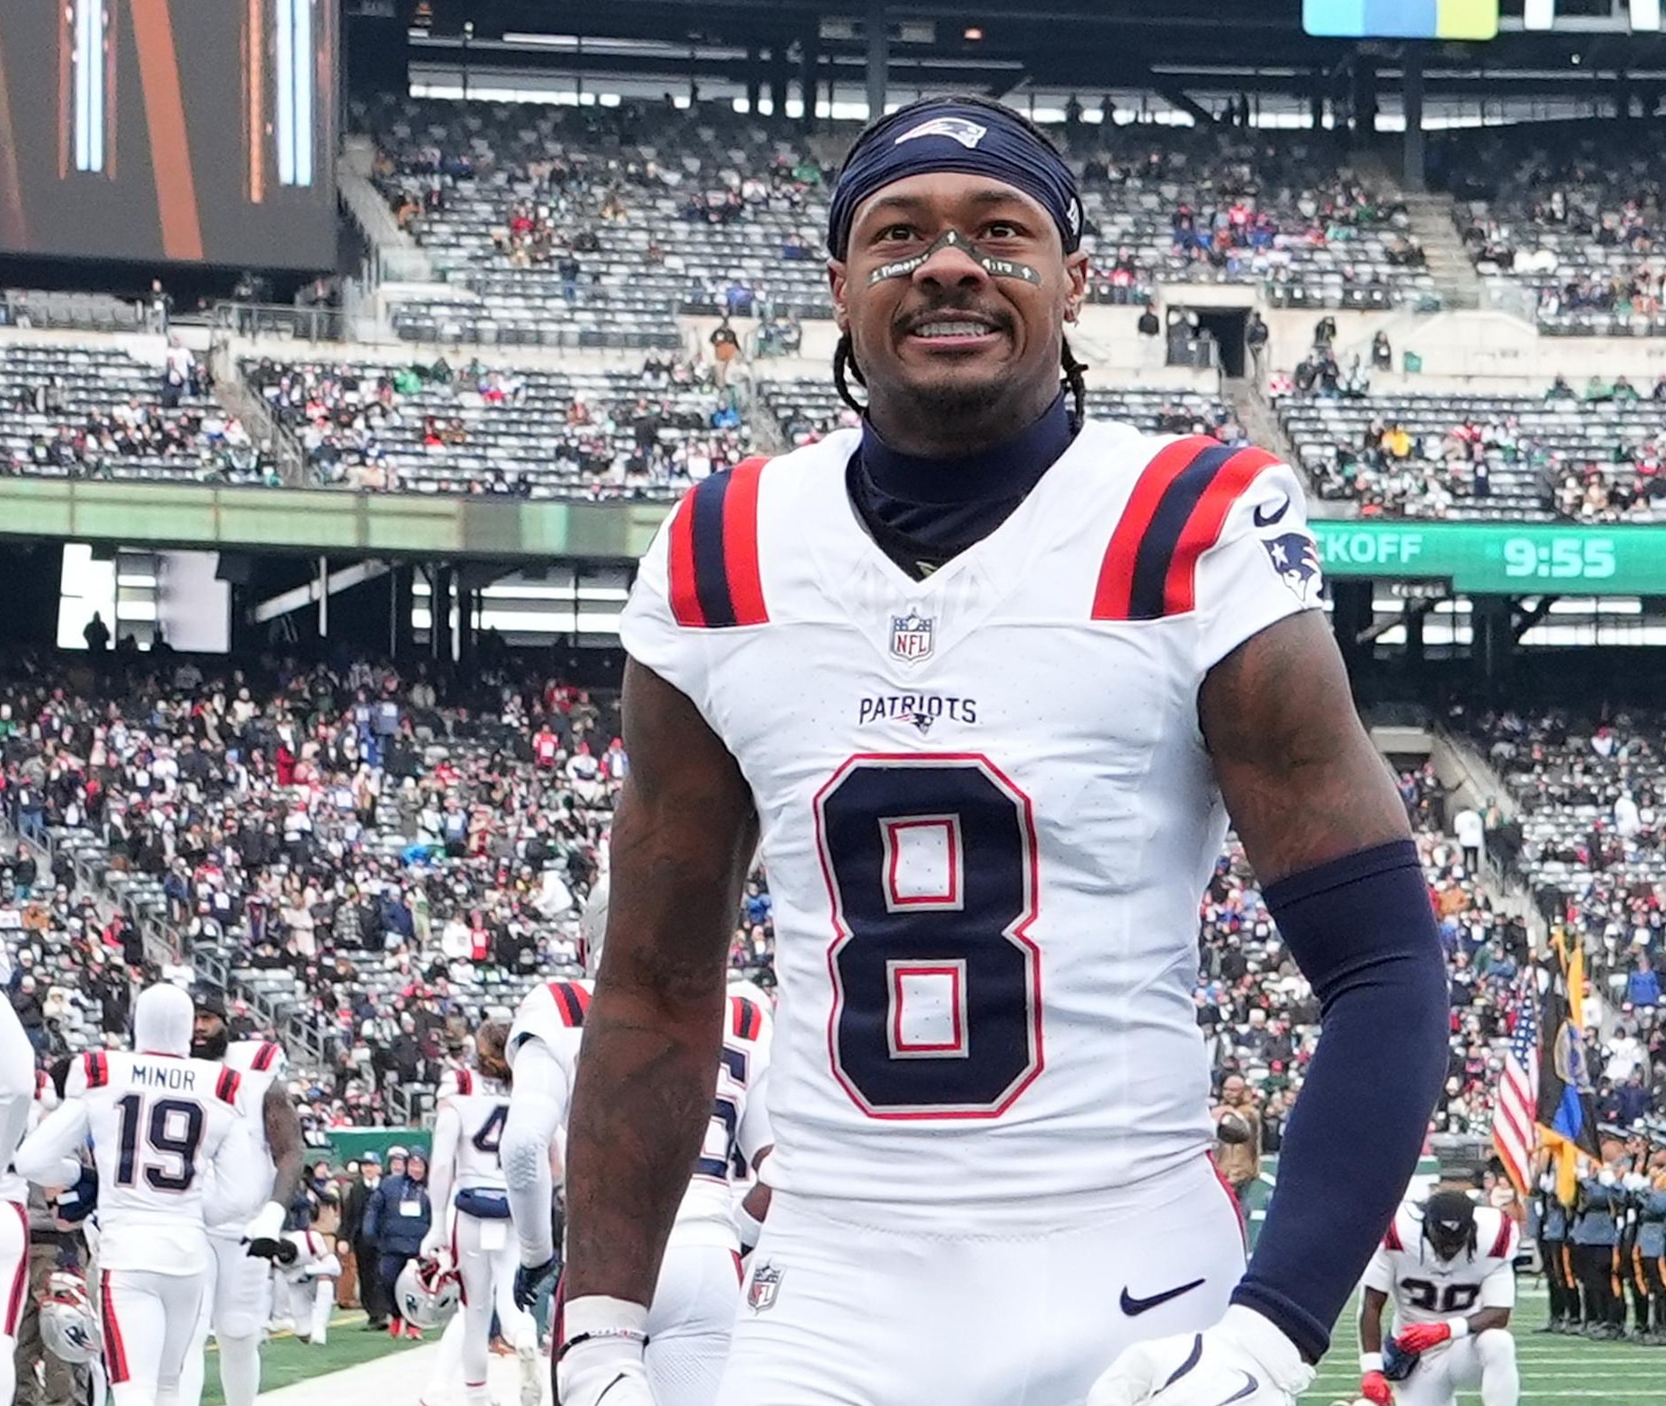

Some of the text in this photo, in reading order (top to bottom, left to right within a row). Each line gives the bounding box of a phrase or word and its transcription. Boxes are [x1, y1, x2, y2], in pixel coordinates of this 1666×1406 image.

[1503, 538, 1616, 578] 9:55
[896, 633, 927, 657] NFL
[858, 695, 977, 725] PATRIOTS
[813, 752, 1045, 1120] 8
[132, 1064, 196, 1091] MINOR
[114, 1093, 207, 1195] 19
